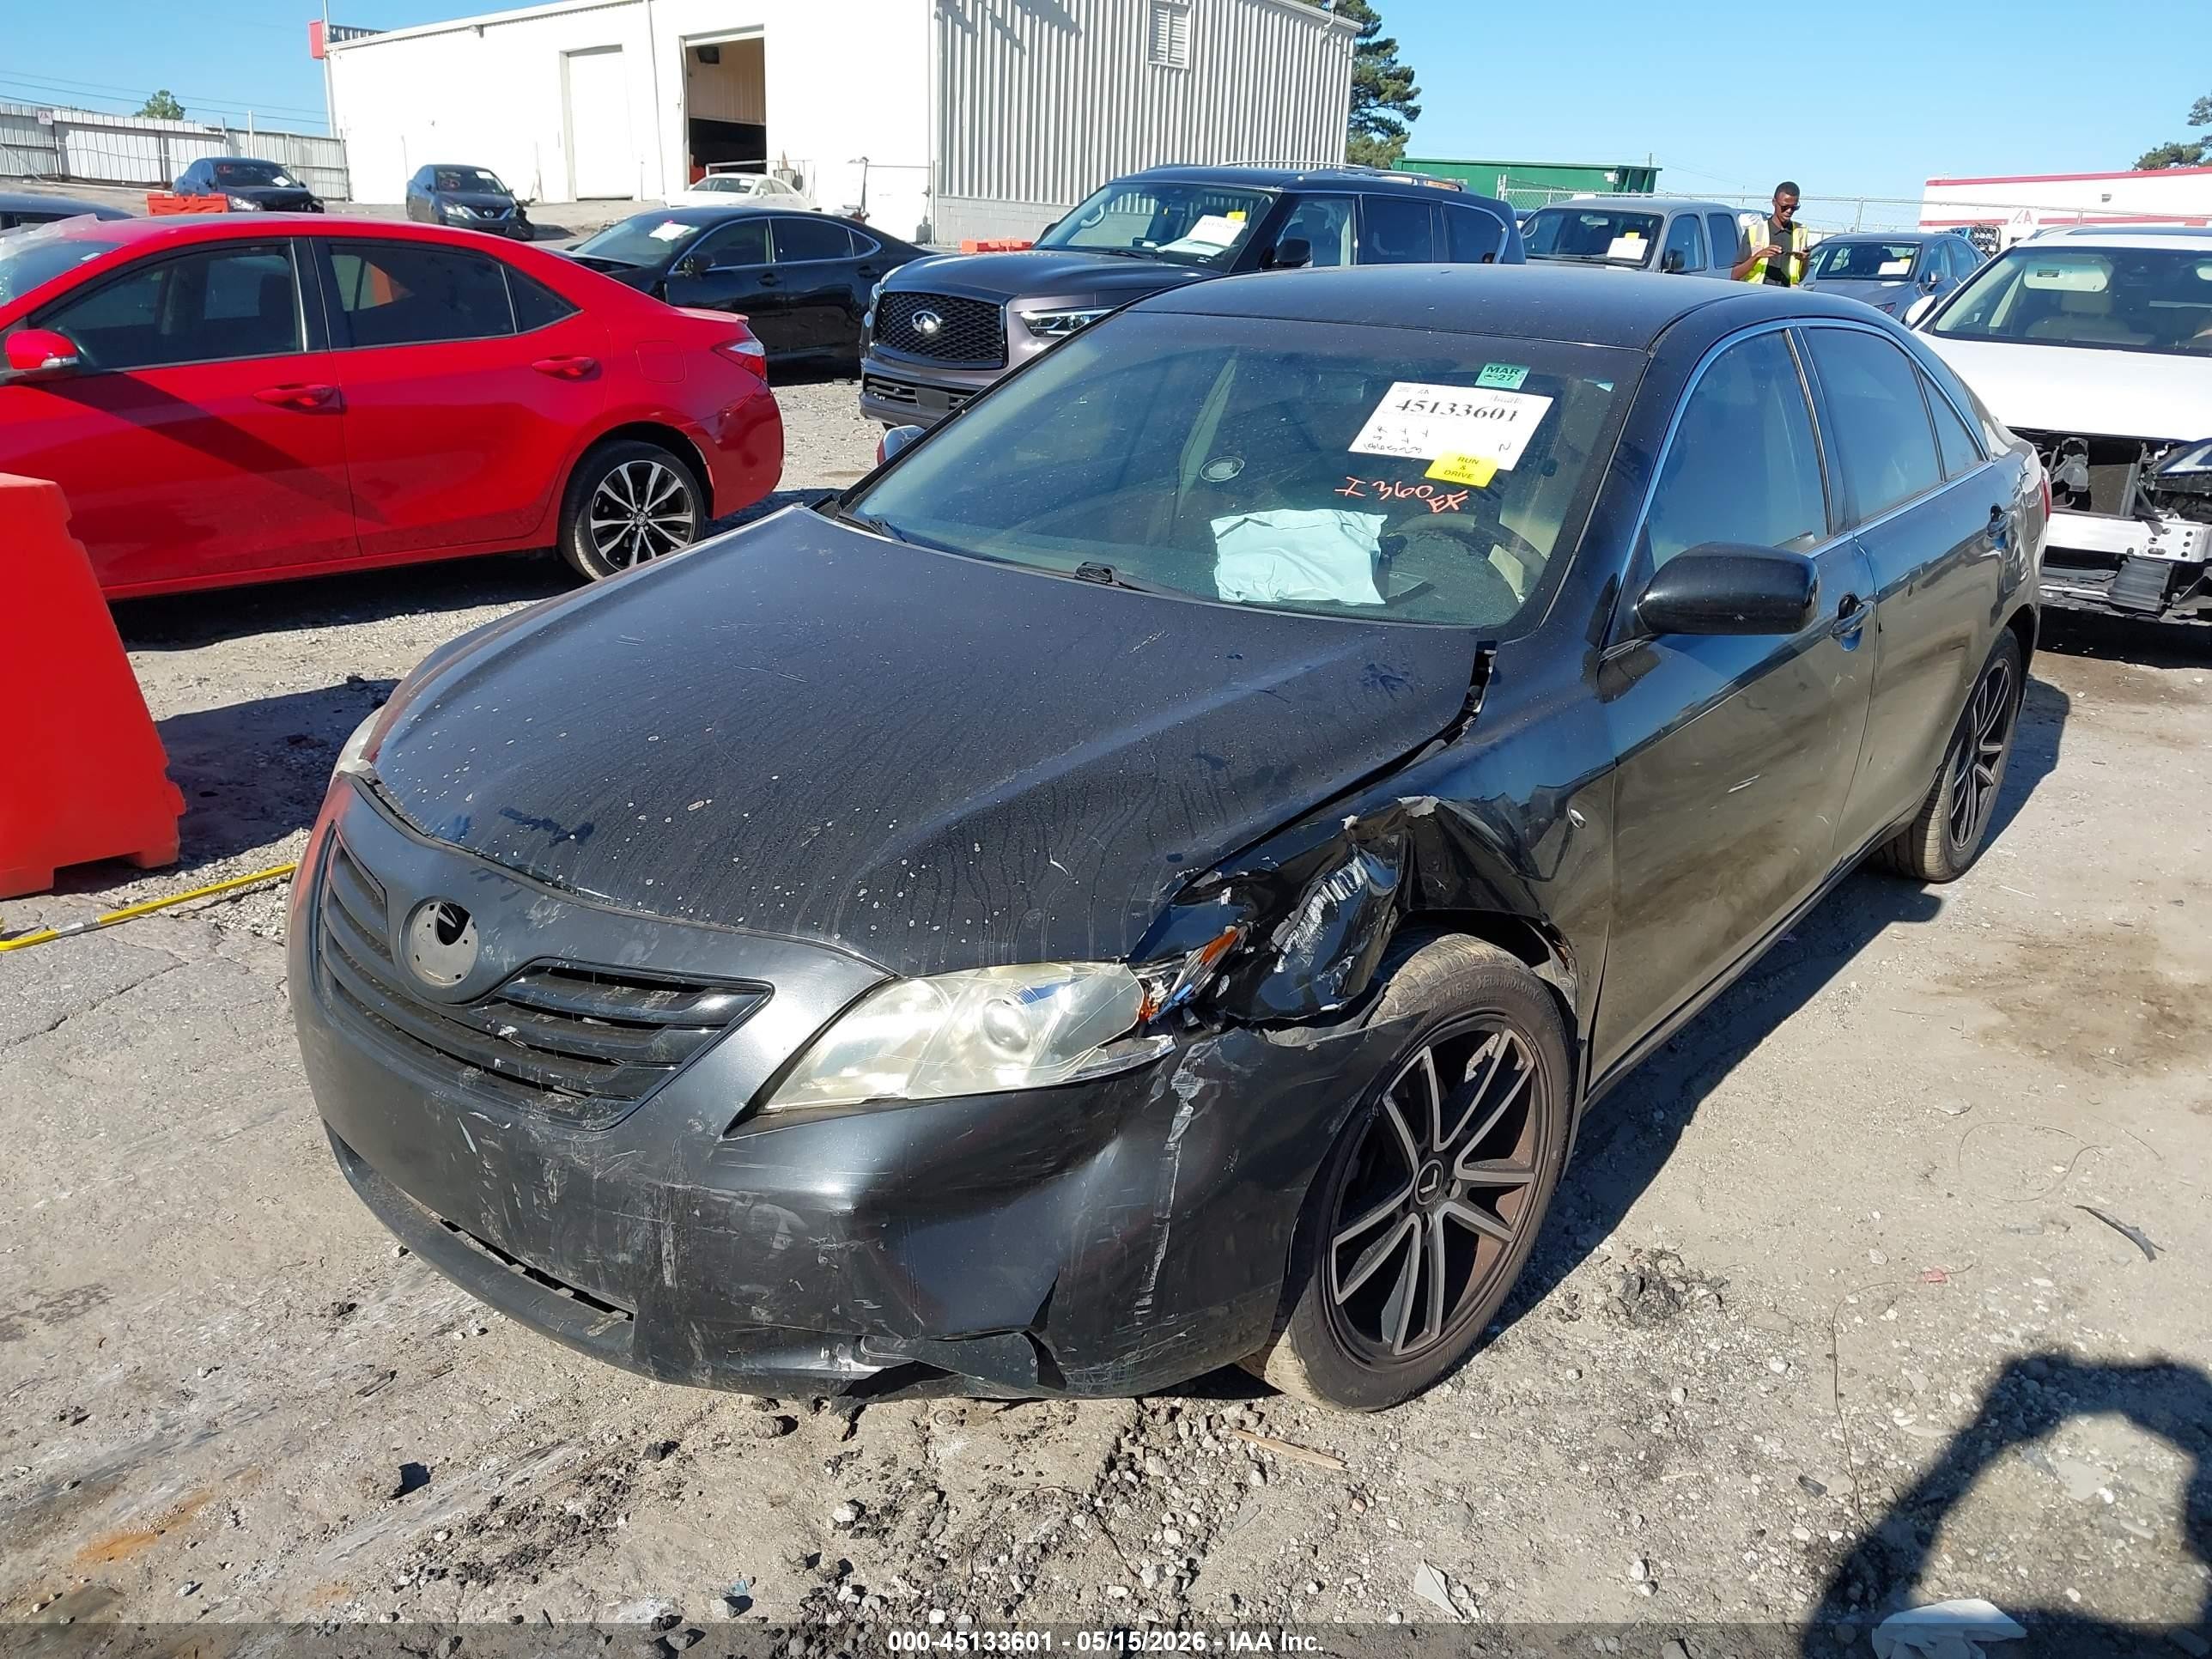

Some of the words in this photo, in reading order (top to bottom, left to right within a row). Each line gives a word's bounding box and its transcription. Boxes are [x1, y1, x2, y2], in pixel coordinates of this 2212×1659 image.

[1486, 366, 1520, 375] MAR
[1395, 398, 1518, 422] 45133601
[1457, 456, 1480, 465] RUN
[1443, 469, 1475, 480] DRIVE
